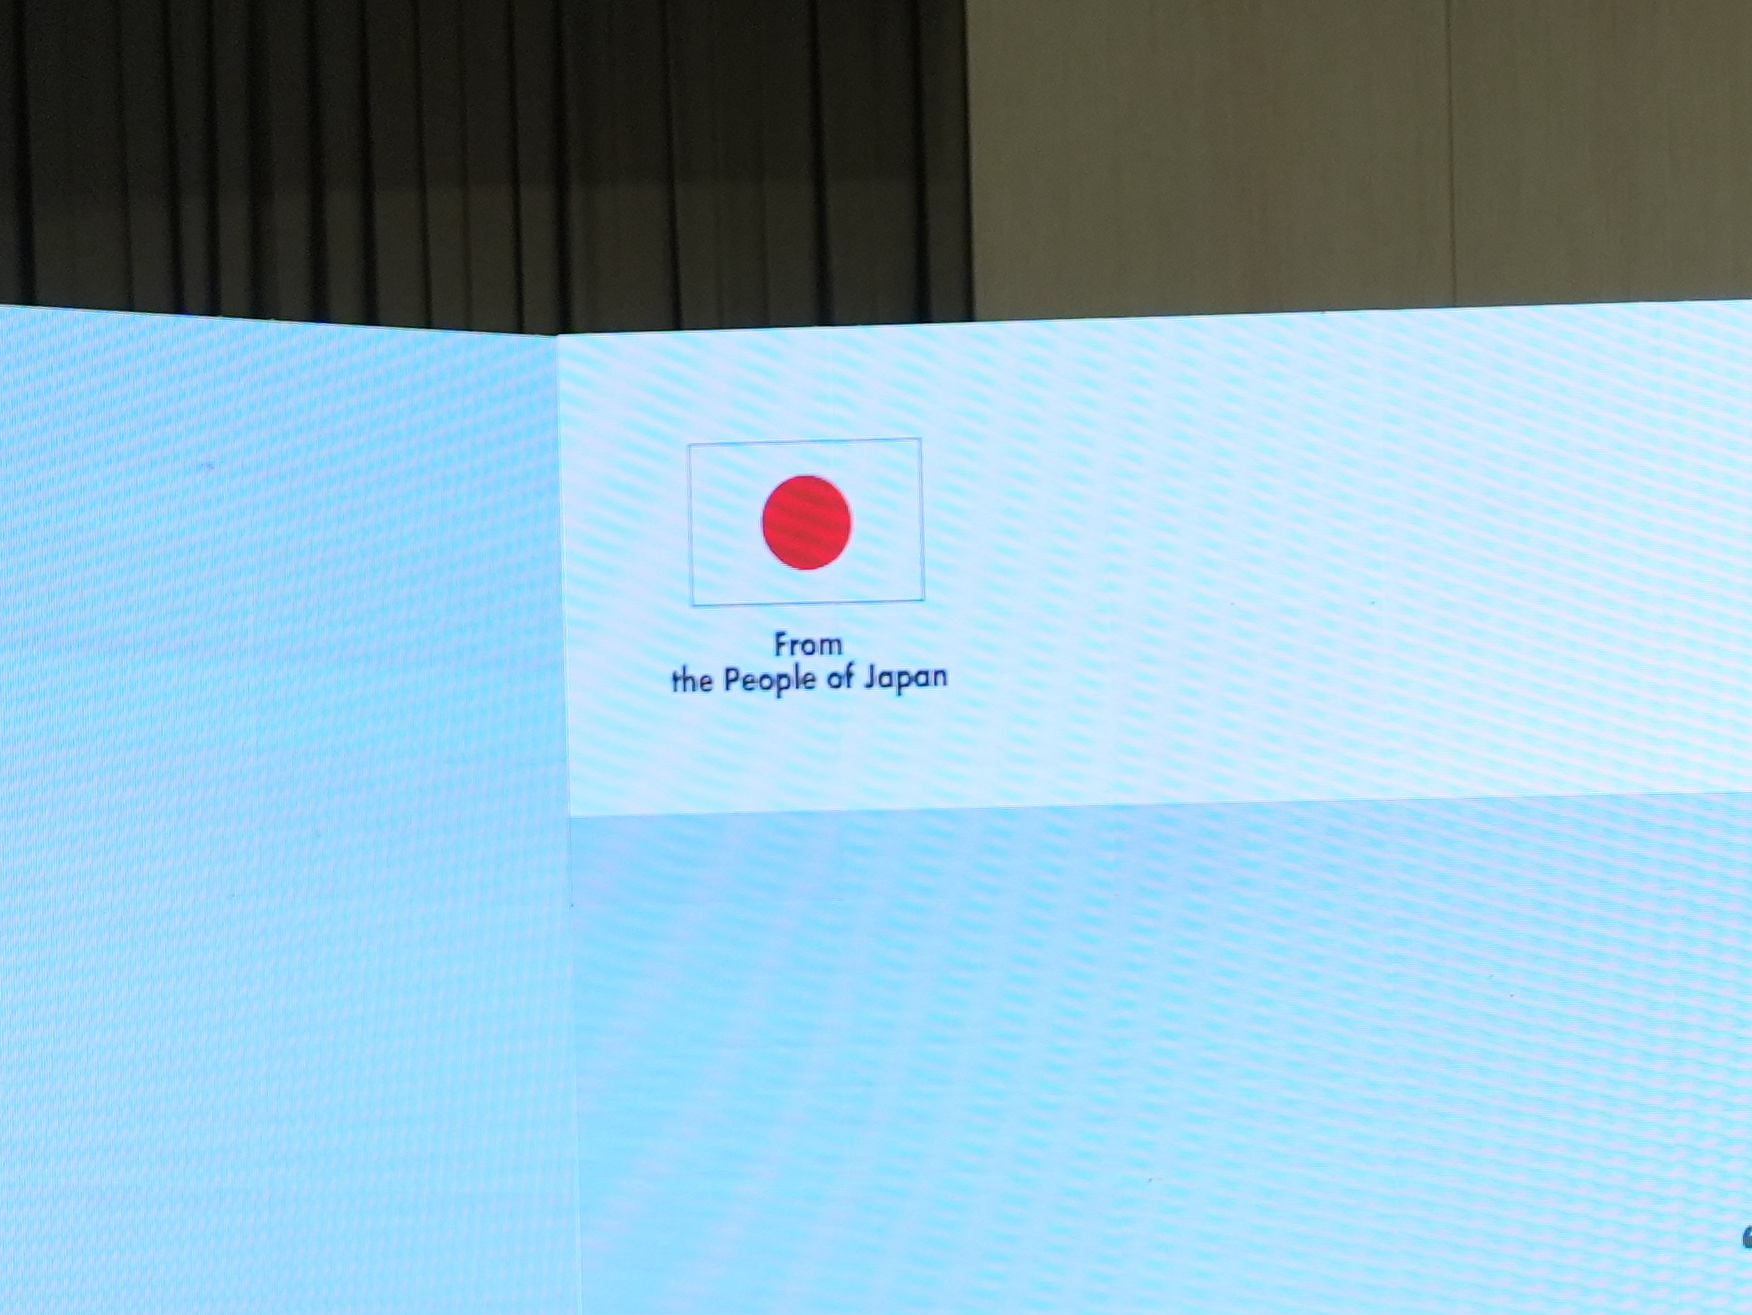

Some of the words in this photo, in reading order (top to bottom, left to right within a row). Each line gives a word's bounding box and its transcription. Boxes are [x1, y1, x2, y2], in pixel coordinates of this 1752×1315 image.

[774, 631, 843, 656] From
[672, 664, 712, 692] the
[725, 662, 817, 699] People
[827, 660, 856, 689] of
[864, 662, 948, 697] Japan
